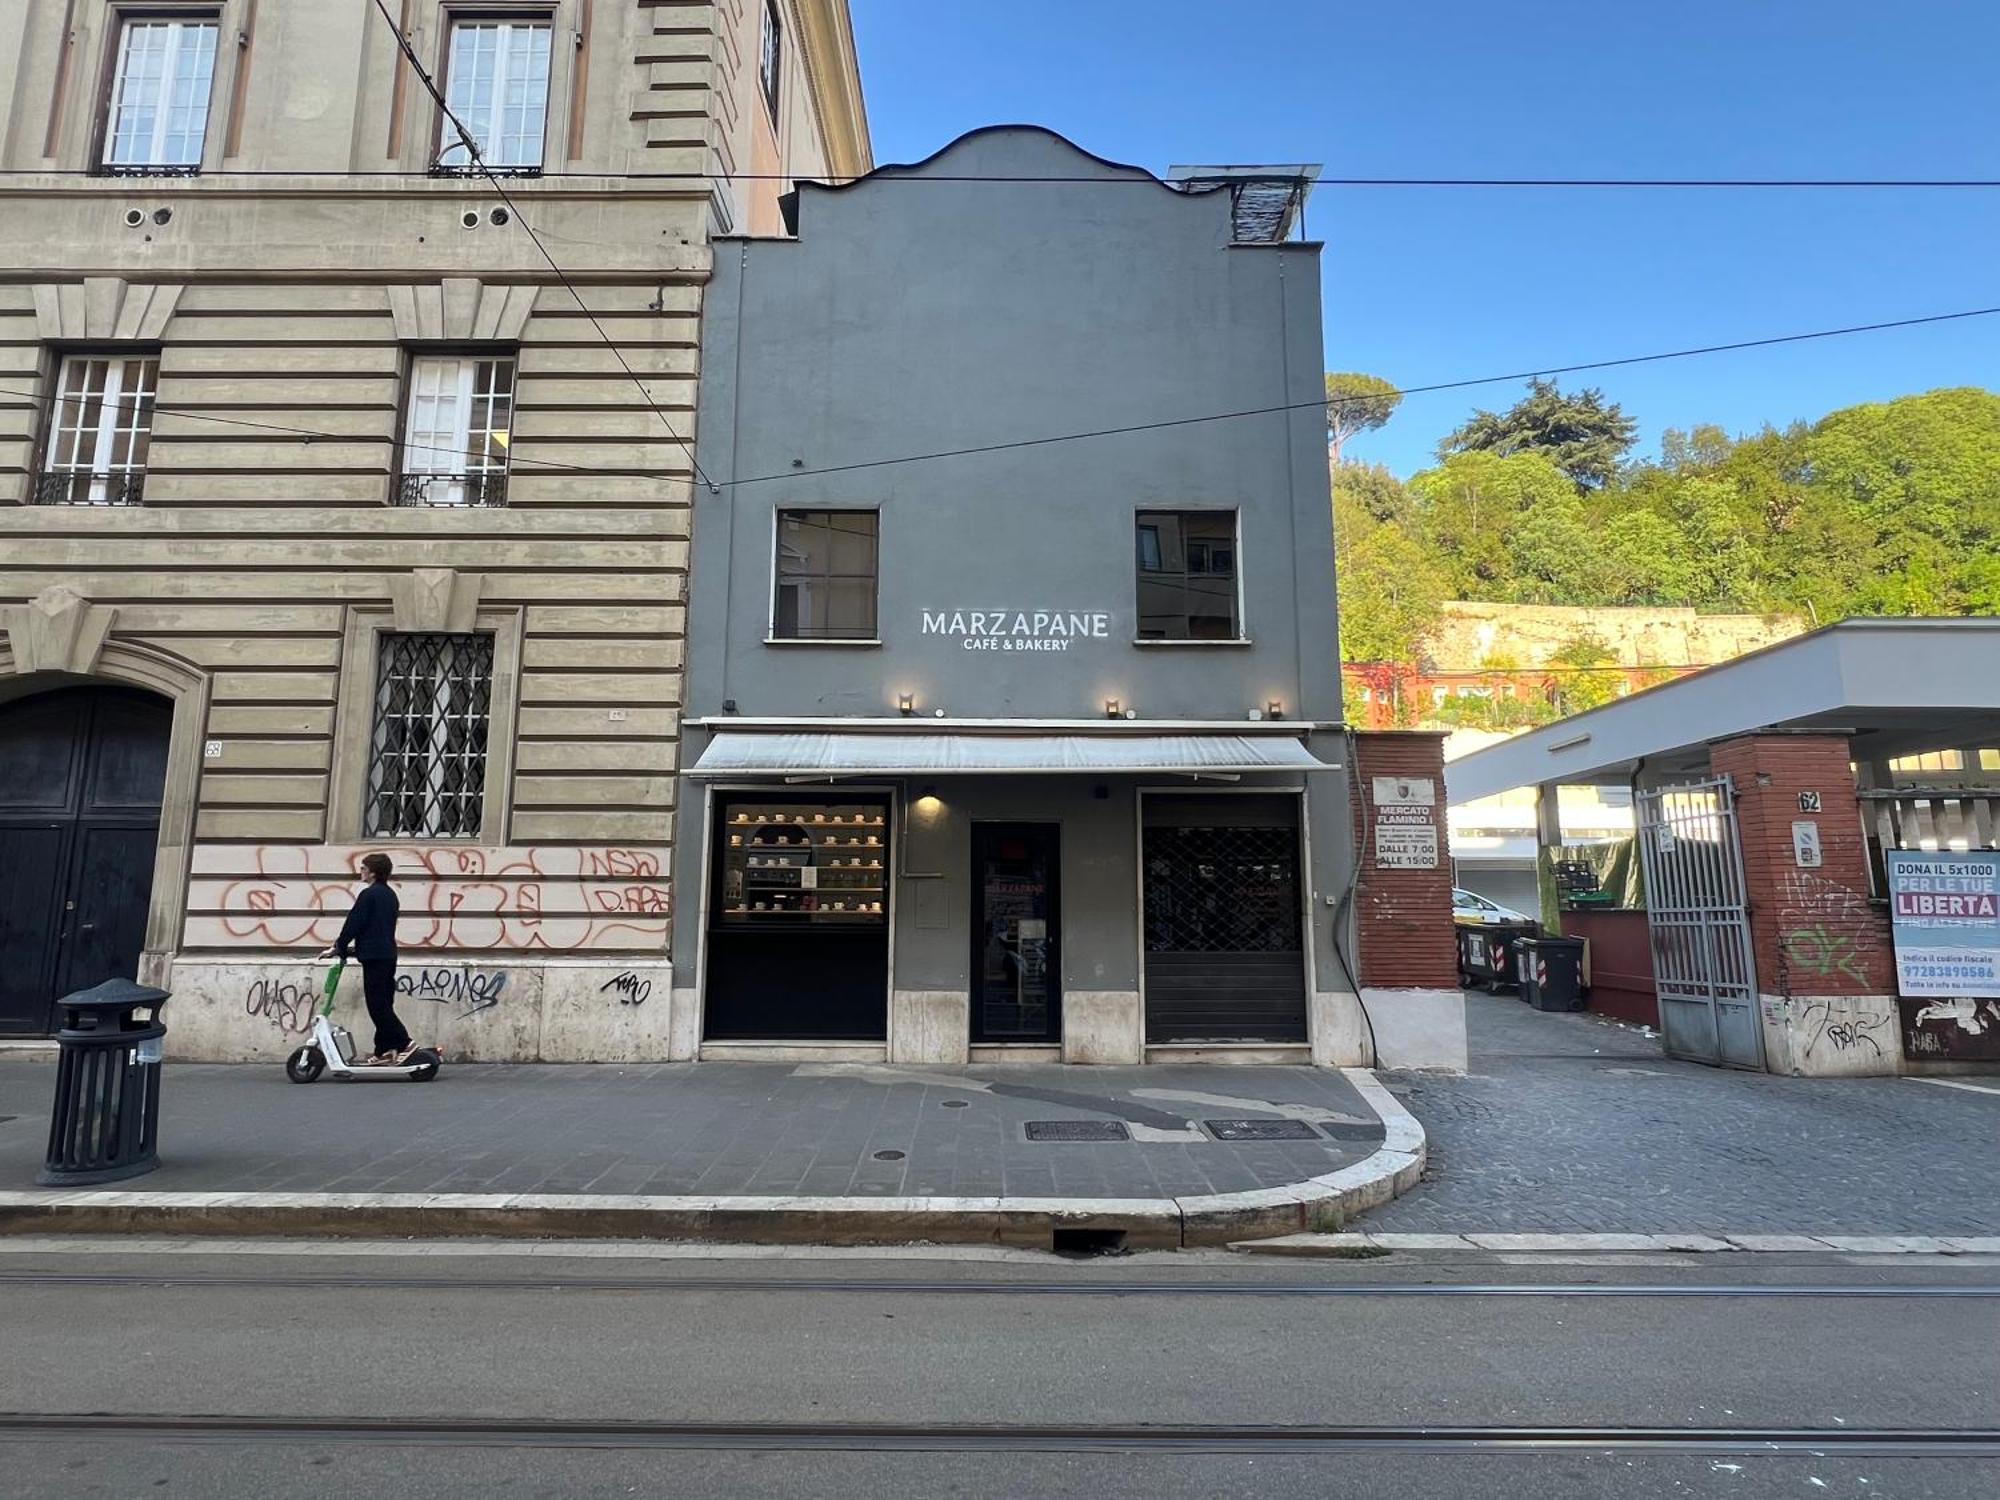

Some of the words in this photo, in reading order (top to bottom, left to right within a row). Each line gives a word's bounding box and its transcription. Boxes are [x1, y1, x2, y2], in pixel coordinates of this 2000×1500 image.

[921, 612, 1109, 637] MARZAPANE
[963, 637, 998, 650] CAFÉ
[1002, 639, 1013, 650] &
[1015, 639, 1069, 651] BAKERY
[1800, 792, 1819, 811] 62
[1380, 806, 1429, 815] MERCATO
[1378, 816, 1427, 824] FLAMINIO
[1379, 845, 1408, 853] DALLE
[1380, 856, 1403, 864] ALLE
[1897, 863, 1931, 874] DONA
[1934, 864, 1946, 875] IL
[1948, 864, 1993, 876] 5x1000
[1898, 878, 1930, 892] PER
[1935, 878, 1955, 892] LE
[1959, 878, 1993, 892] TUE
[1964, 955, 1993, 963] fiscale
